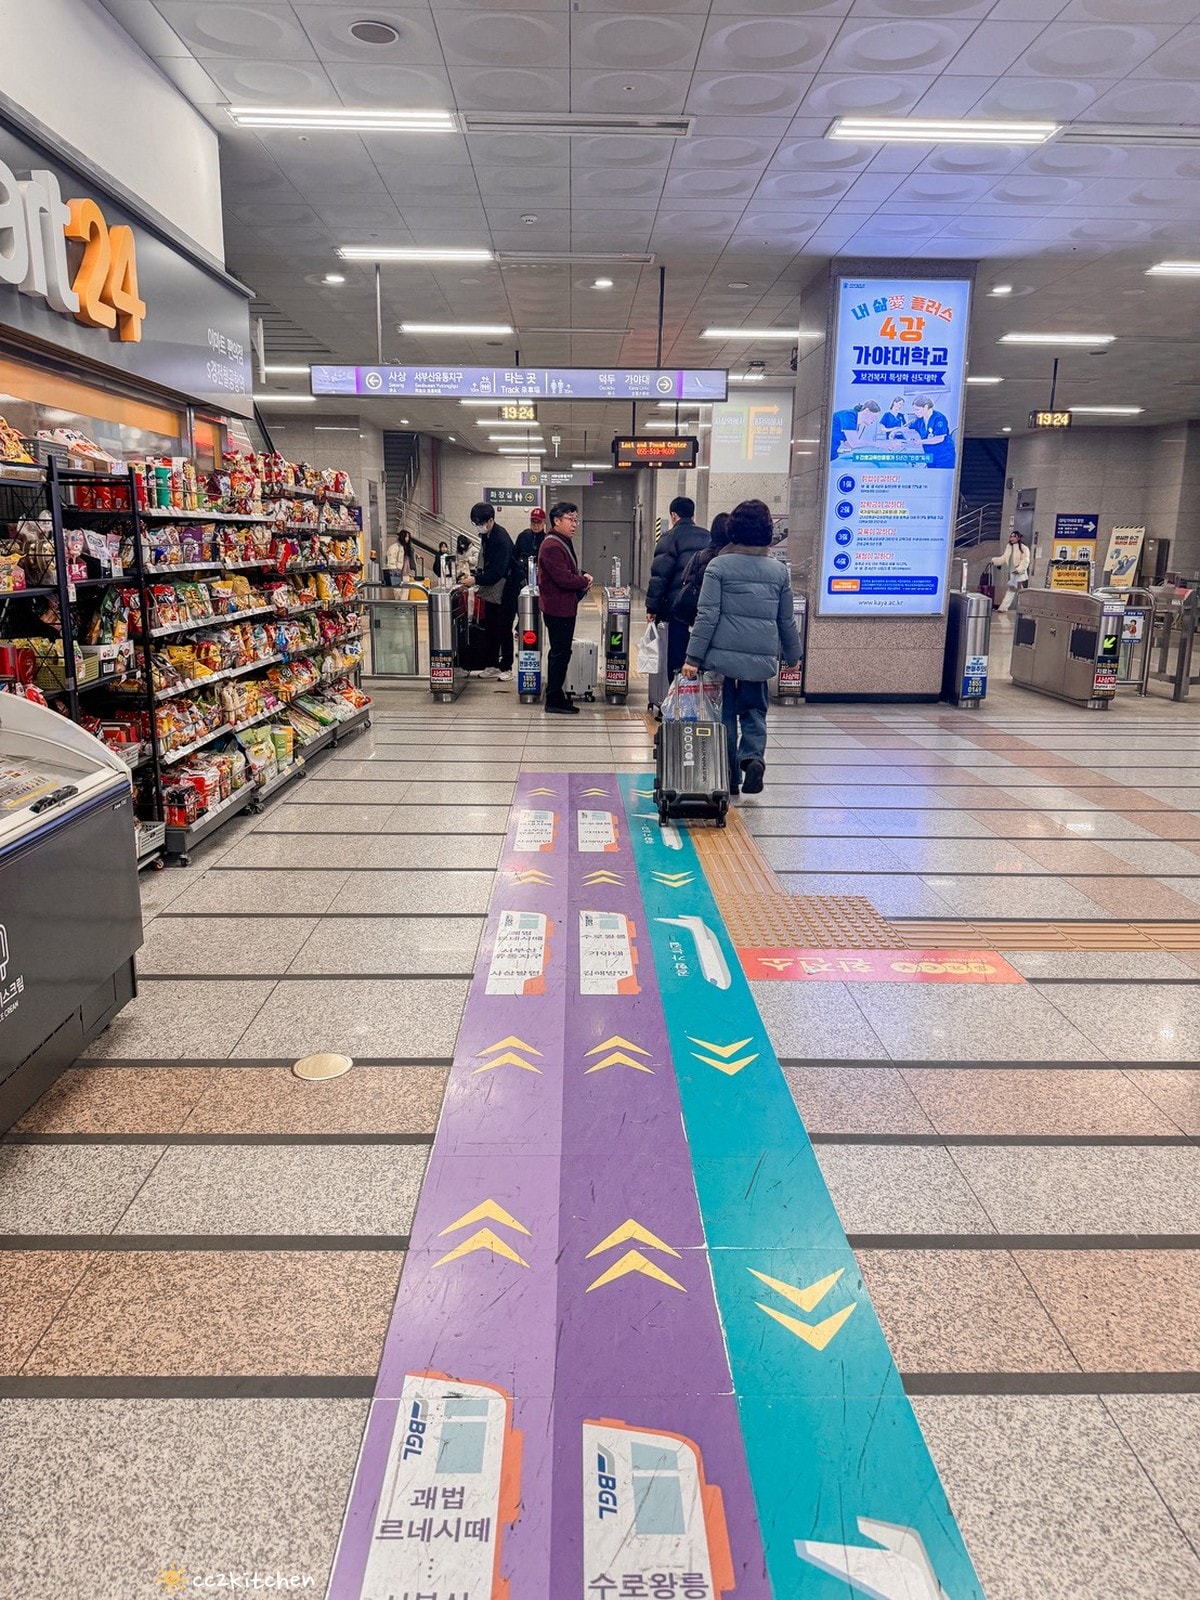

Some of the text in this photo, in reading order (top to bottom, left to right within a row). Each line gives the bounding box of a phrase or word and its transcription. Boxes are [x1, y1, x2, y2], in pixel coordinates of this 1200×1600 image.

[850, 302, 870, 321] 내
[911, 296, 953, 323] 플러스
[880, 316, 926, 342] 4강
[852, 346, 949, 366] 가야대학교
[388, 372, 464, 383] 사상 서부산유통지구
[504, 372, 537, 384] 타는 곳
[598, 373, 650, 385] 덕두 가야대
[860, 372, 887, 382] 보건복지
[500, 385, 520, 394] Track
[621, 441, 635, 449] Lost
[649, 441, 666, 449] Found
[667, 441, 687, 449] Center
[490, 491, 513, 499] 화장실
[858, 600, 904, 608] www.kaya.ac.kr
[1096, 676, 1115, 684] 사상역
[757, 956, 874, 974] 환전소
[0, 974, 25, 1008] 스크림
[403, 1419, 427, 1460] BGL
[409, 1485, 466, 1511] 괘법
[597, 1472, 618, 1520] BGL
[375, 1516, 491, 1543] 르네시떼
[588, 1572, 710, 1600] 수로왕릉
